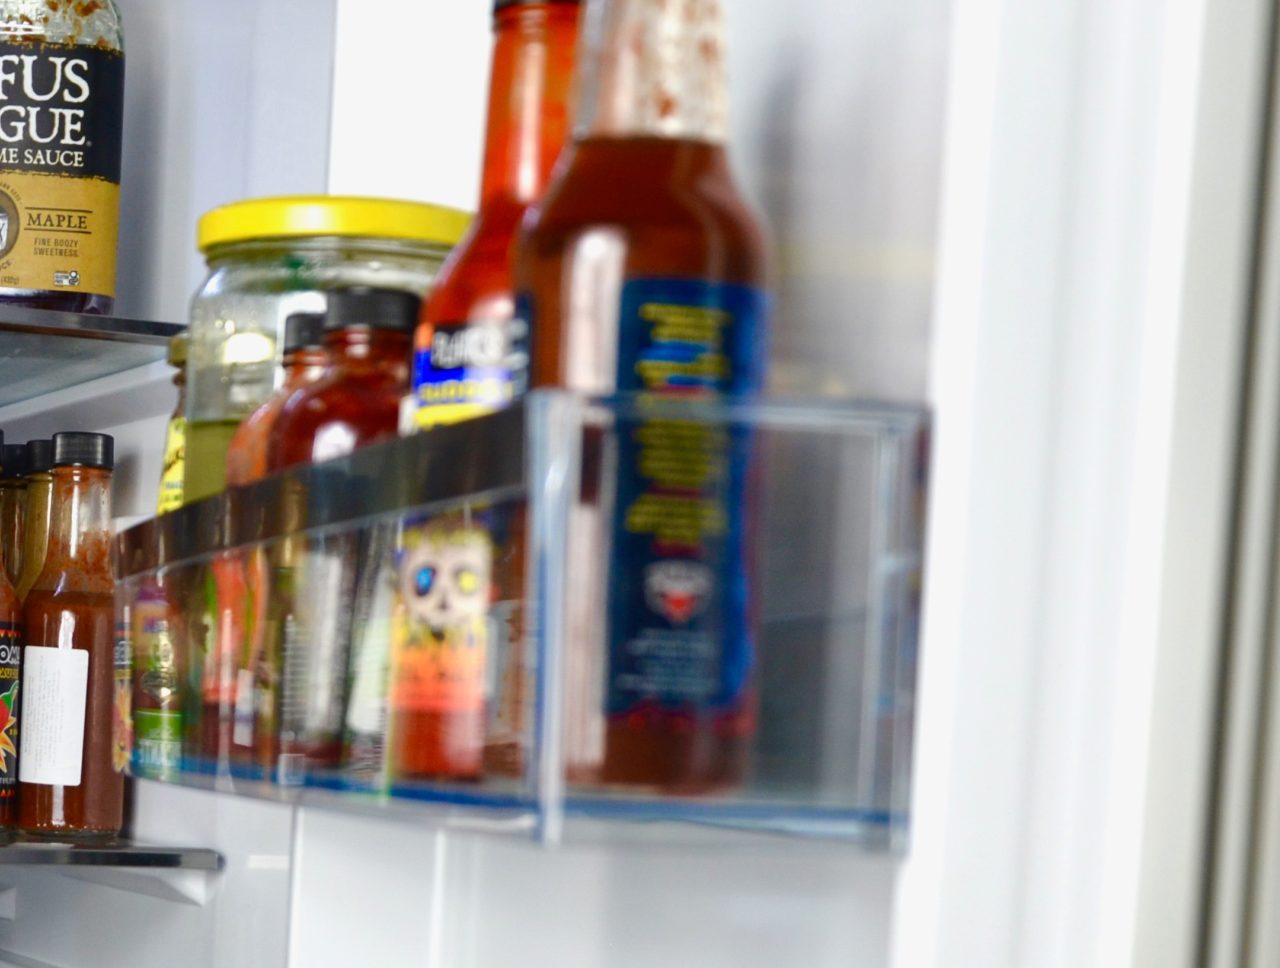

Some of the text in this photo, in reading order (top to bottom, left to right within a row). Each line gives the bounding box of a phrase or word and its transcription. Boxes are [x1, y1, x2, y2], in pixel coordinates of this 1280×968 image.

[24, 149, 84, 167] SAUCE
[27, 213, 88, 230] MAPLE
[33, 238, 78, 248] FINE BOOZY
